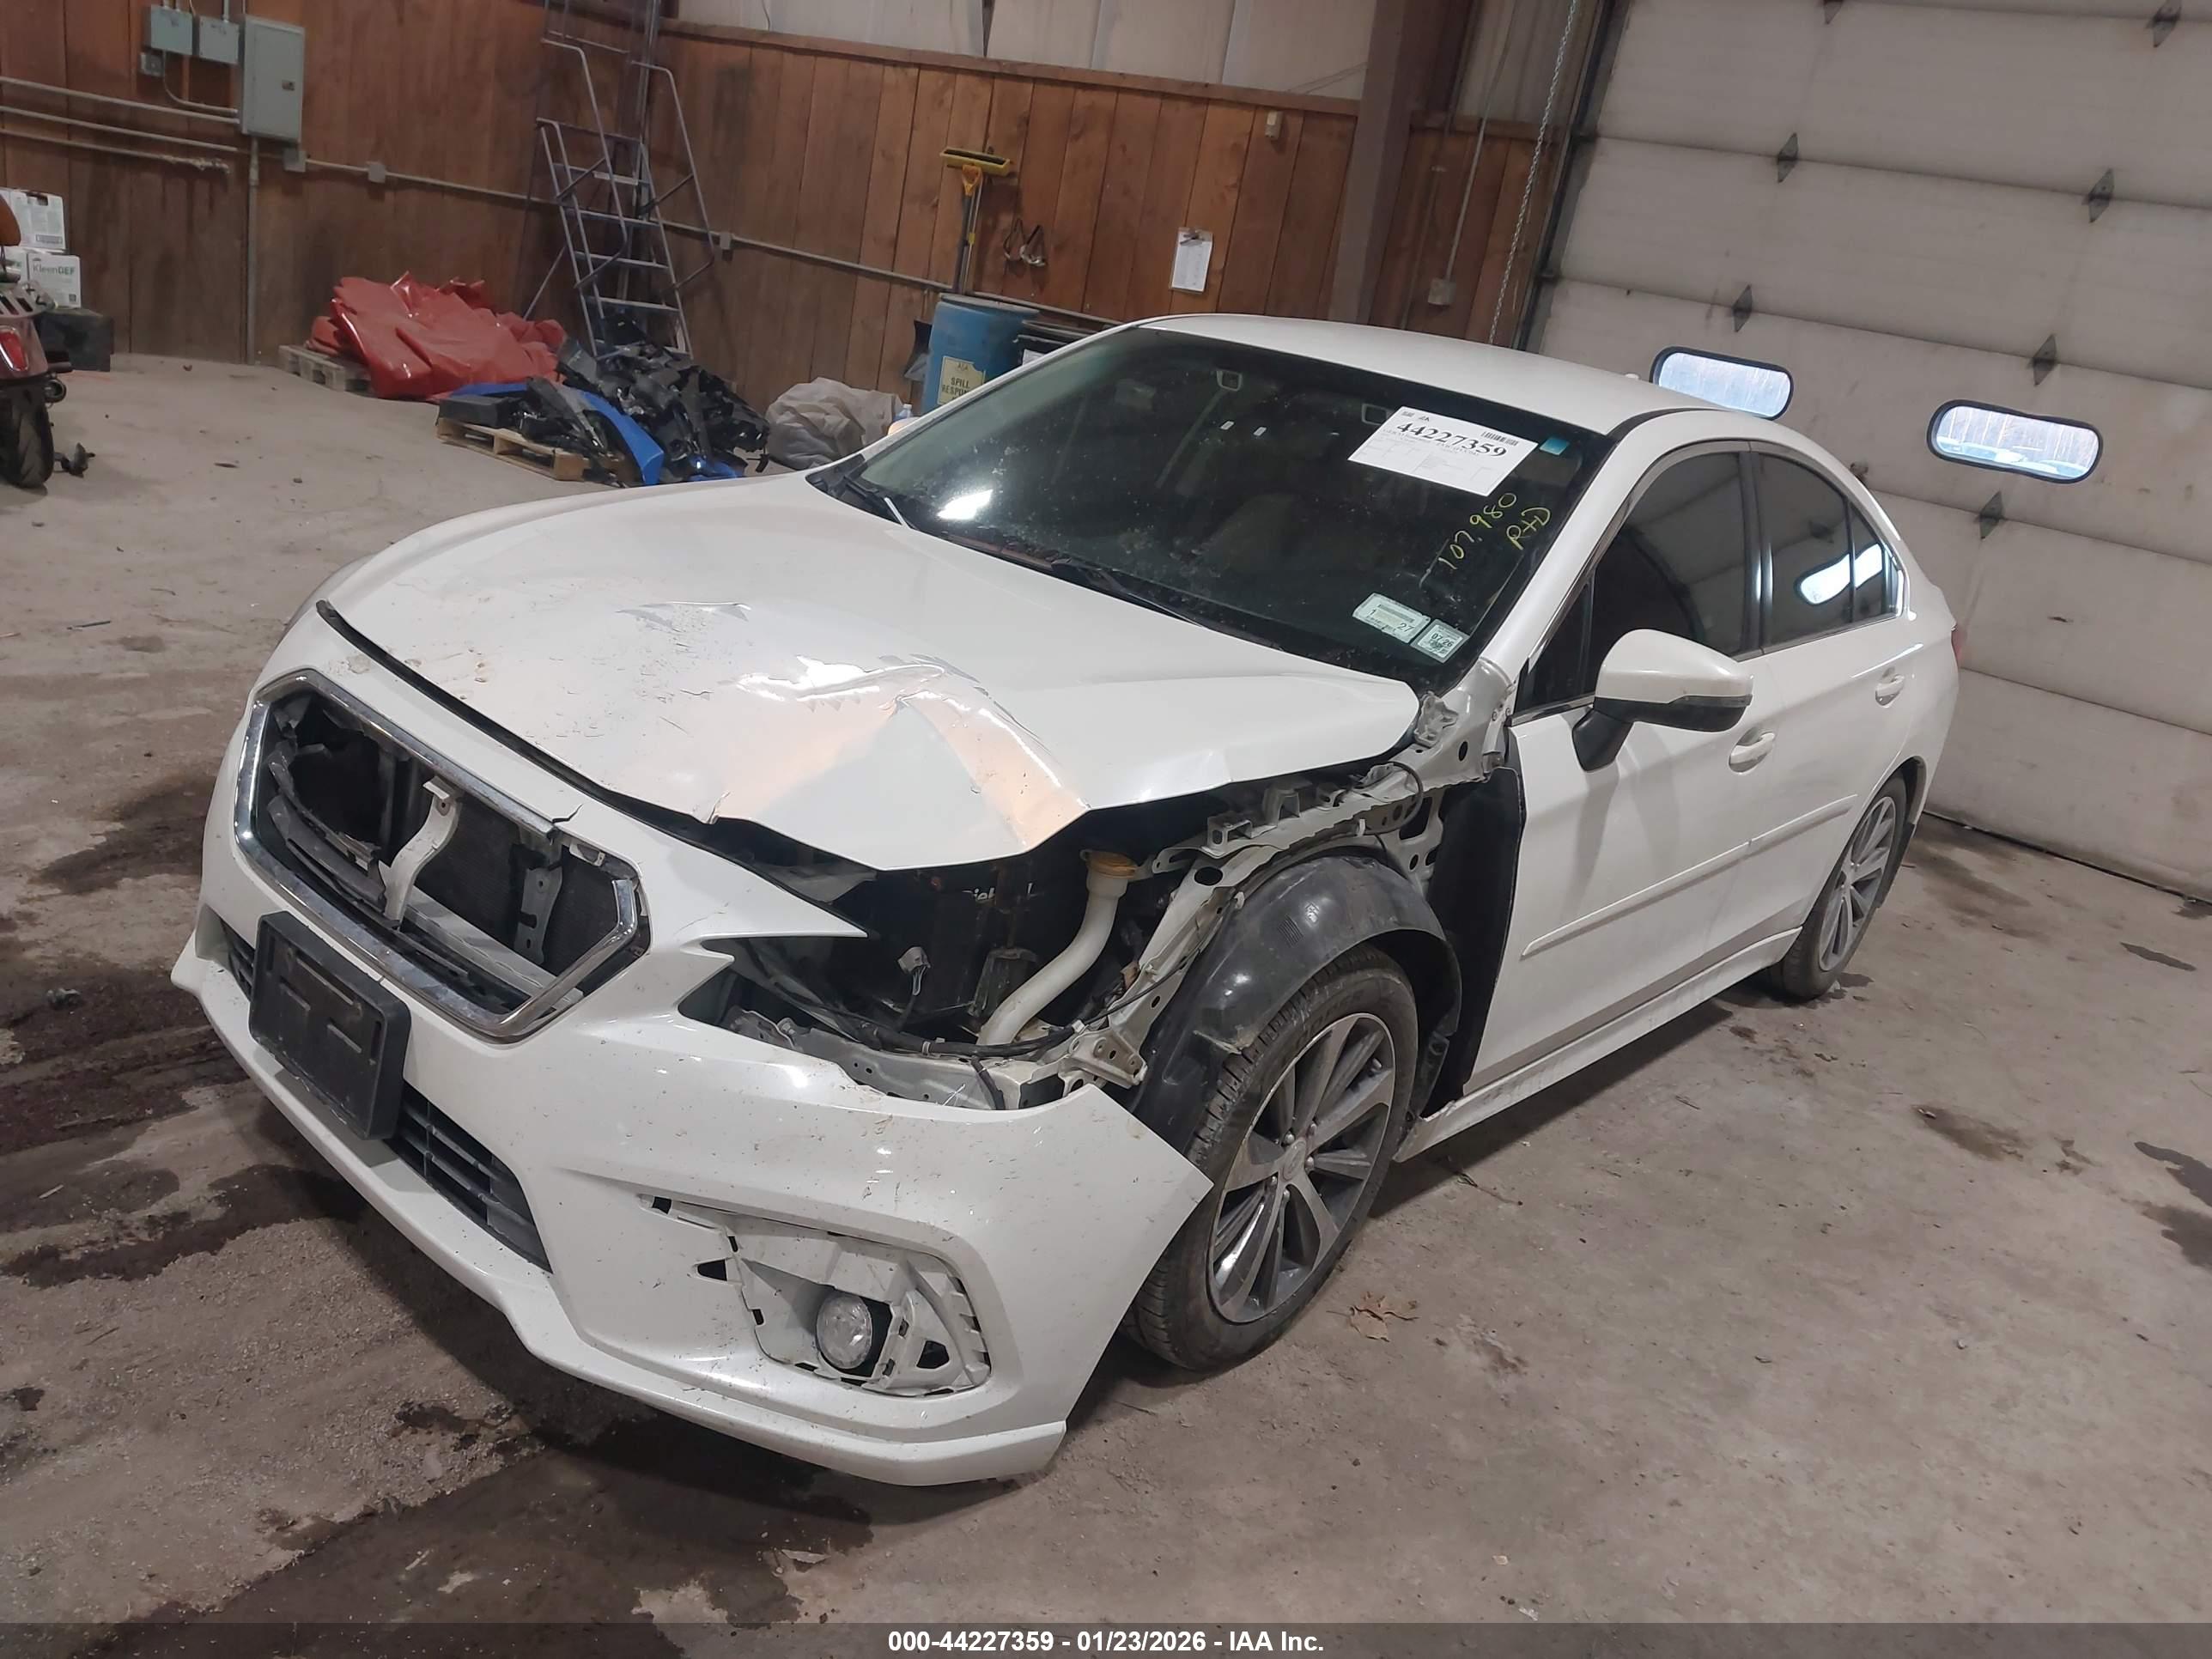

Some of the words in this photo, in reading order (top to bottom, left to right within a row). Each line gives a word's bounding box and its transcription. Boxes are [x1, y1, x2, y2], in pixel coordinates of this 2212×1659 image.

[951, 377, 970, 389] SPILL
[1396, 422, 1507, 458] 44227359
[1396, 622, 1415, 633] 27
